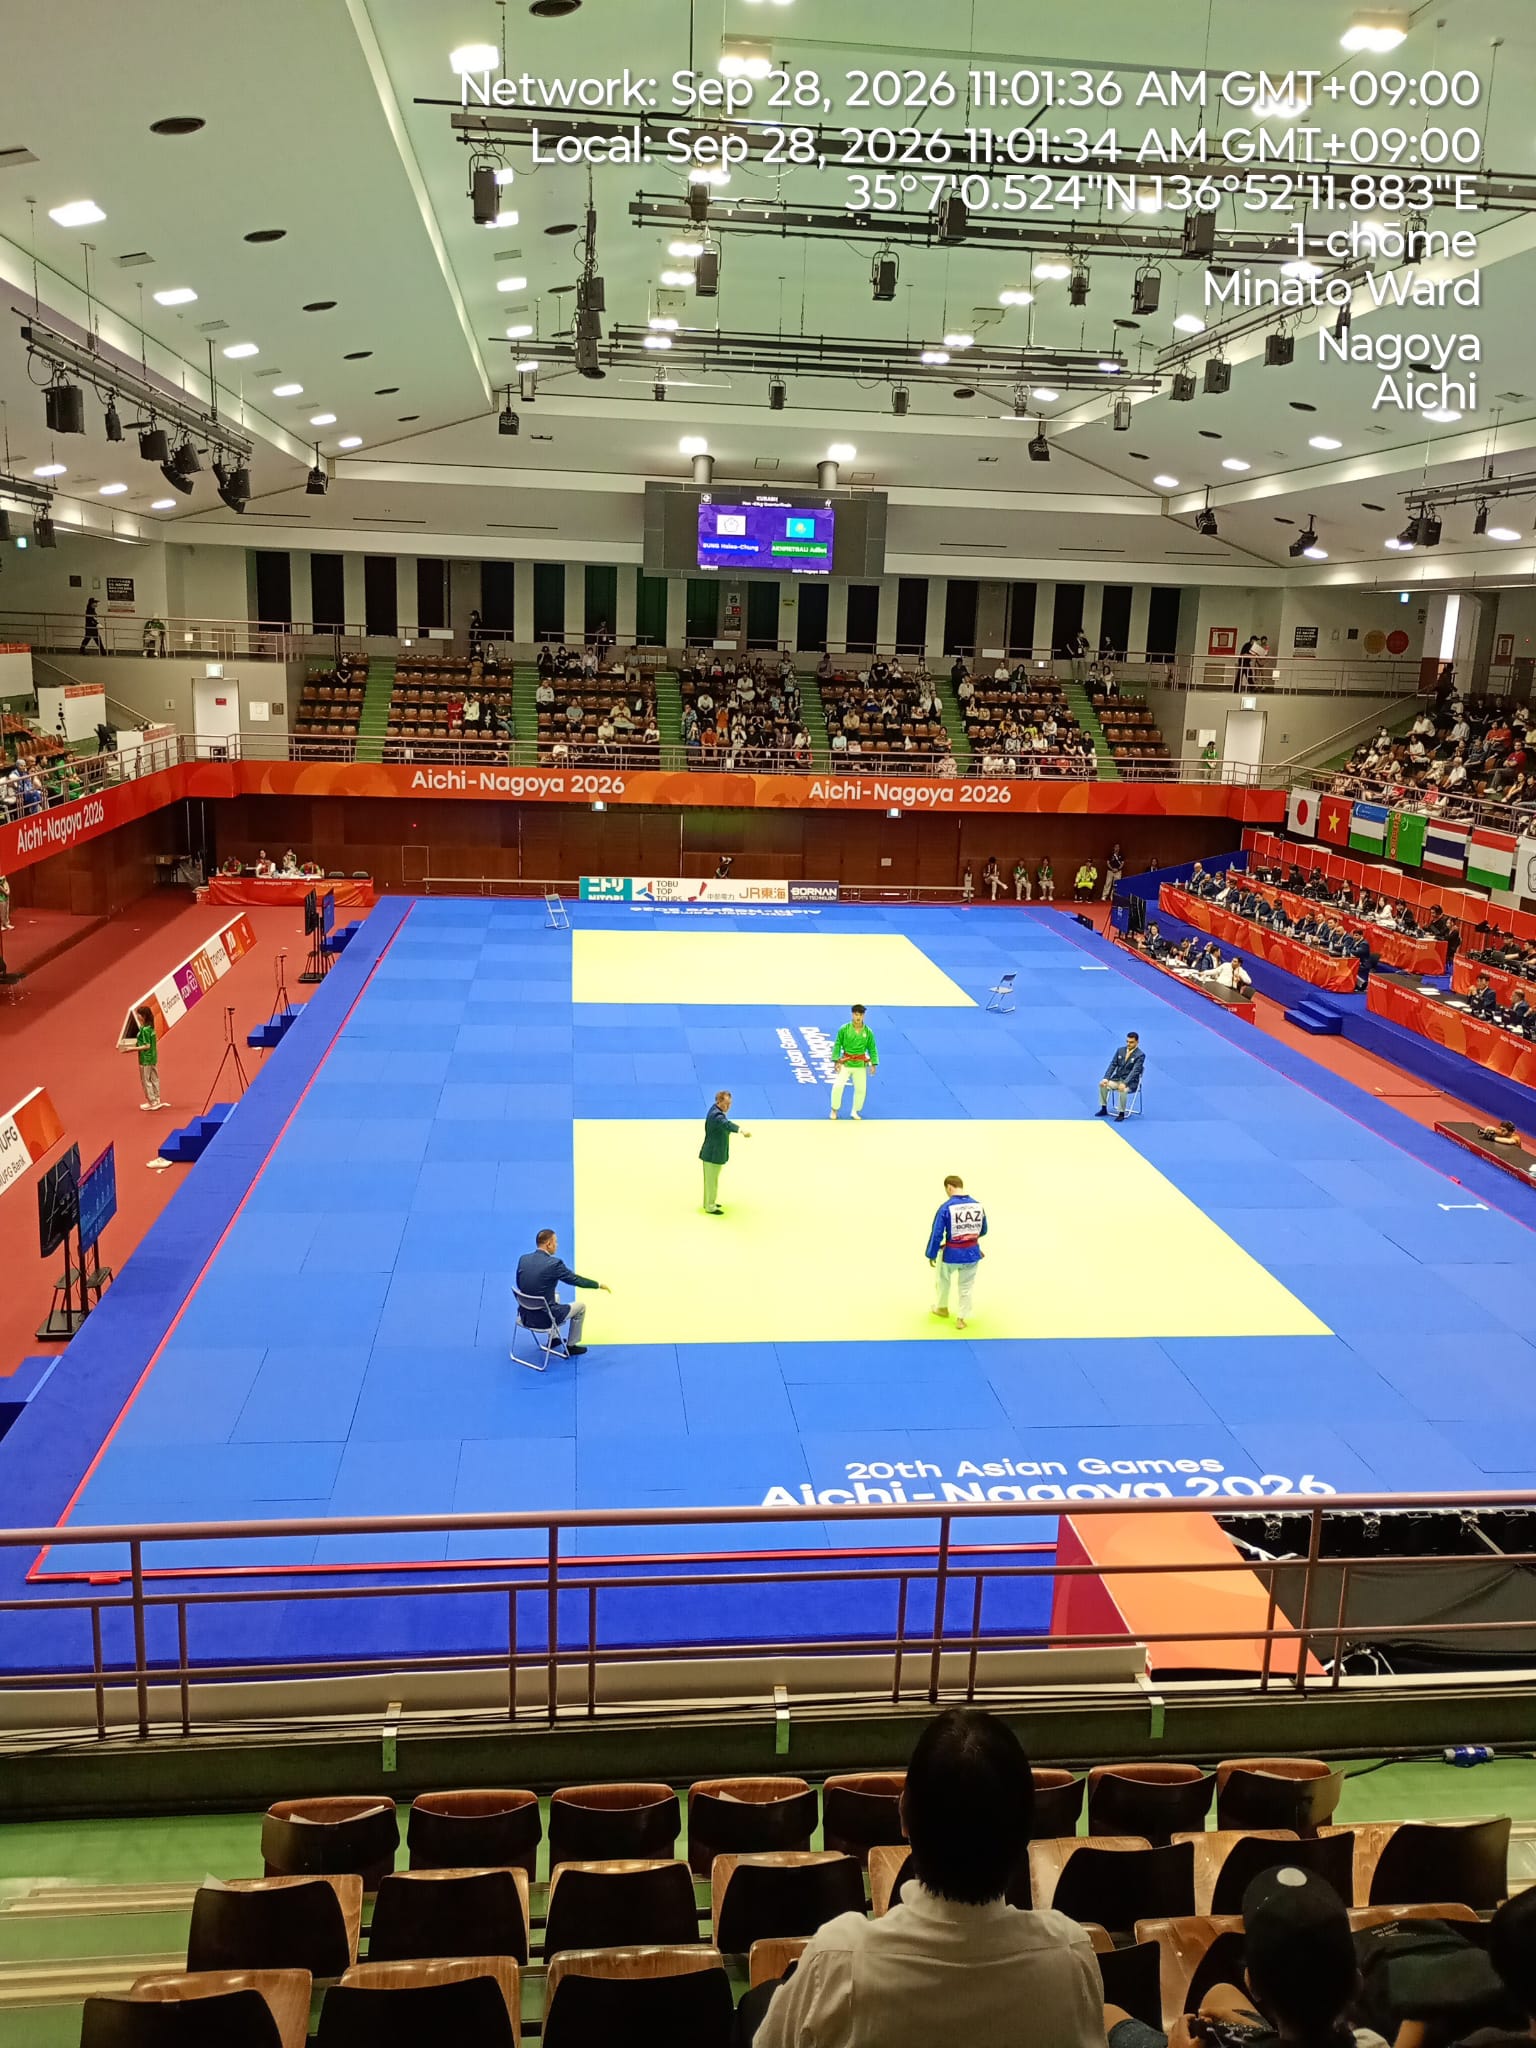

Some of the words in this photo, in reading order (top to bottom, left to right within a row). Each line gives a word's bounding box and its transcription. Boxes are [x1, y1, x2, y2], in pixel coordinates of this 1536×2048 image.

[411, 769, 564, 797] Aichi-Nagoya
[571, 775, 625, 795] 2026
[809, 780, 953, 807] Aichi-Nagoya
[960, 785, 1013, 805] 2026
[17, 811, 82, 855] Aichi-Nagoya
[83, 799, 104, 828] 2026
[588, 879, 624, 893] ニトリ
[656, 880, 679, 888] TOBU
[739, 887, 786, 899] JR東海
[791, 887, 837, 896] BORNAN
[955, 1210, 981, 1223] KAZ
[845, 1460, 943, 1479] 20th
[957, 1458, 1068, 1478] Asian
[1077, 1457, 1225, 1476] Games
[1185, 1474, 1337, 1498] 2026
